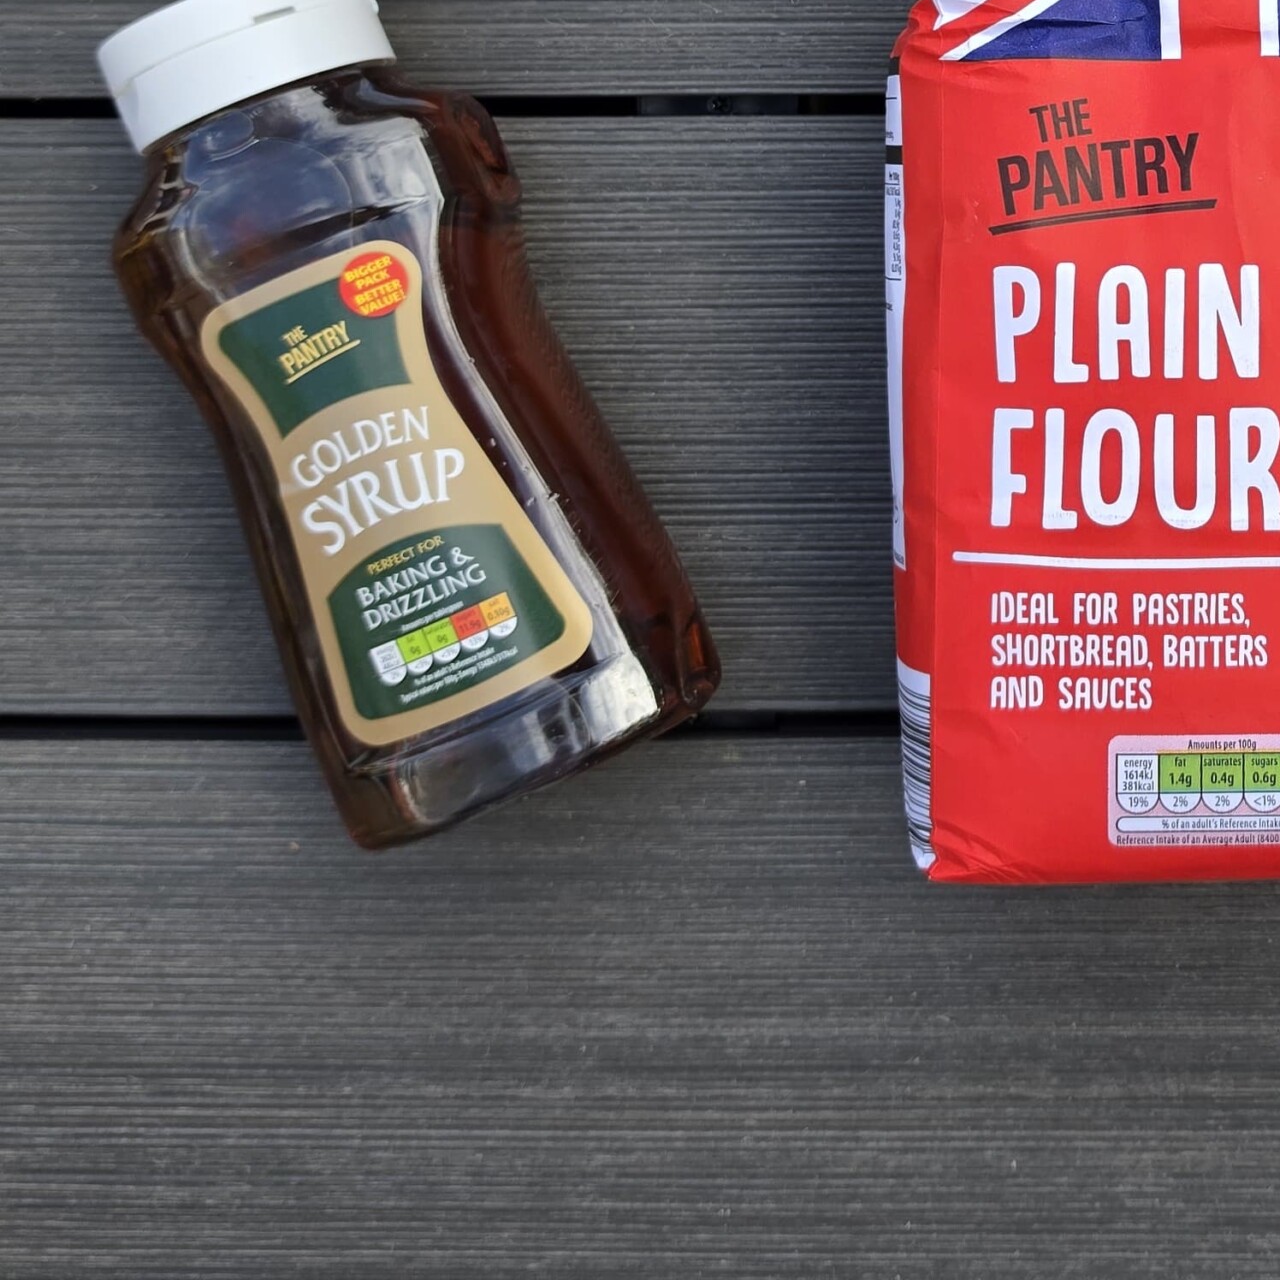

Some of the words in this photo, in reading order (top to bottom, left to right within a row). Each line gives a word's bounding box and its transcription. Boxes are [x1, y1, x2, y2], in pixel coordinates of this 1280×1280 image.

[1029, 97, 1093, 142] THE
[996, 132, 1201, 217] PANTRY
[344, 255, 392, 282] BIGGER
[355, 269, 390, 290] PACK
[354, 278, 402, 306] BETTER
[359, 290, 407, 316] VALUE!
[992, 262, 1260, 384] PLAIN
[282, 325, 308, 347] THE
[279, 320, 350, 376] PANTRY
[291, 406, 430, 489] GOLDEN
[302, 447, 465, 557] SYRUP
[367, 547, 416, 575] PERFECT
[417, 535, 444, 554] FOR
[355, 555, 448, 609] BAKING
[451, 547, 474, 565] &
[362, 563, 487, 631] DRIZZLING
[990, 591, 1059, 624] IDEAL
[1073, 592, 1118, 625] FOR
[1132, 592, 1251, 628] PASTRIES,
[990, 633, 1154, 671] SHORTBREAD,
[1163, 634, 1268, 667] BATTERS
[990, 675, 1043, 709] AND
[1058, 676, 1153, 710] SAUCES
[1188, 739, 1222, 750] Amounts
[1223, 741, 1236, 751] per
[1238, 739, 1257, 751] 100g
[1124, 758, 1153, 769] energy
[1174, 757, 1186, 768] fat
[1203, 756, 1242, 768] saturates
[1251, 757, 1278, 769] sugars
[1122, 780, 1155, 791] 381kcal
[1124, 770, 1153, 780] 1614kJ
[1169, 772, 1192, 788] 1.4g
[1210, 771, 1234, 787] 0.4g
[1252, 771, 1277, 786] 0.6g
[1128, 797, 1149, 808] 19%
[1172, 796, 1189, 807] 2%
[1215, 795, 1231, 807] 2%
[1253, 795, 1277, 806] <1%
[1162, 819, 1170, 829] %
[1171, 818, 1179, 829] of
[1180, 821, 1190, 829] an
[1191, 818, 1218, 829] adult's
[1219, 818, 1257, 829] Reference
[1116, 834, 1155, 845] Reference
[1156, 834, 1180, 844] Intake
[1181, 834, 1190, 844] of
[1191, 836, 1201, 844] an
[1202, 834, 1233, 846] Average
[1235, 833, 1255, 844] Adult
